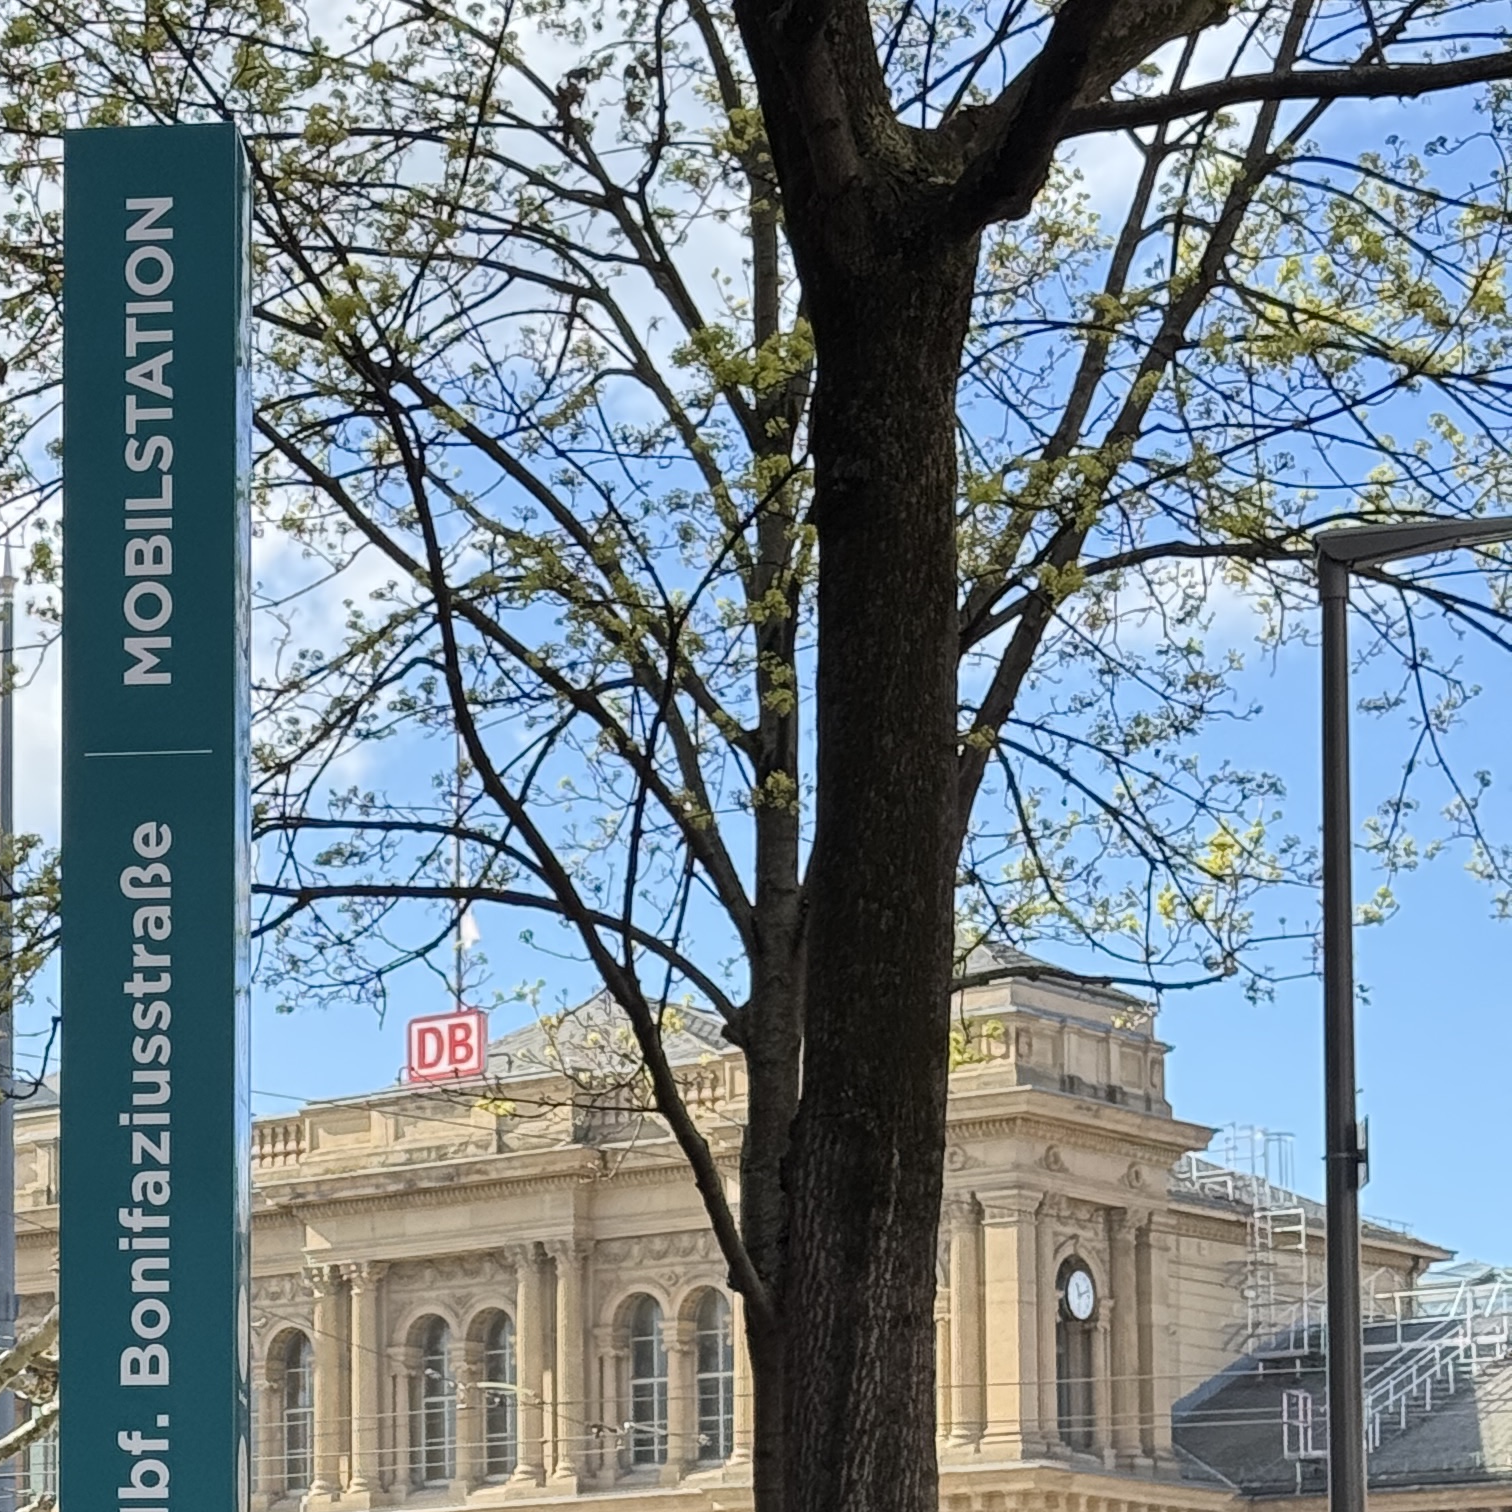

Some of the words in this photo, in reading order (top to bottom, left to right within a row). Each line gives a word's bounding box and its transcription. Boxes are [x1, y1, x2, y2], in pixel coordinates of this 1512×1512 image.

[123, 195, 174, 686] MOBILSTATION
[118, 821, 172, 1387] Bonifaziusstraße
[417, 1022, 474, 1069] DB
